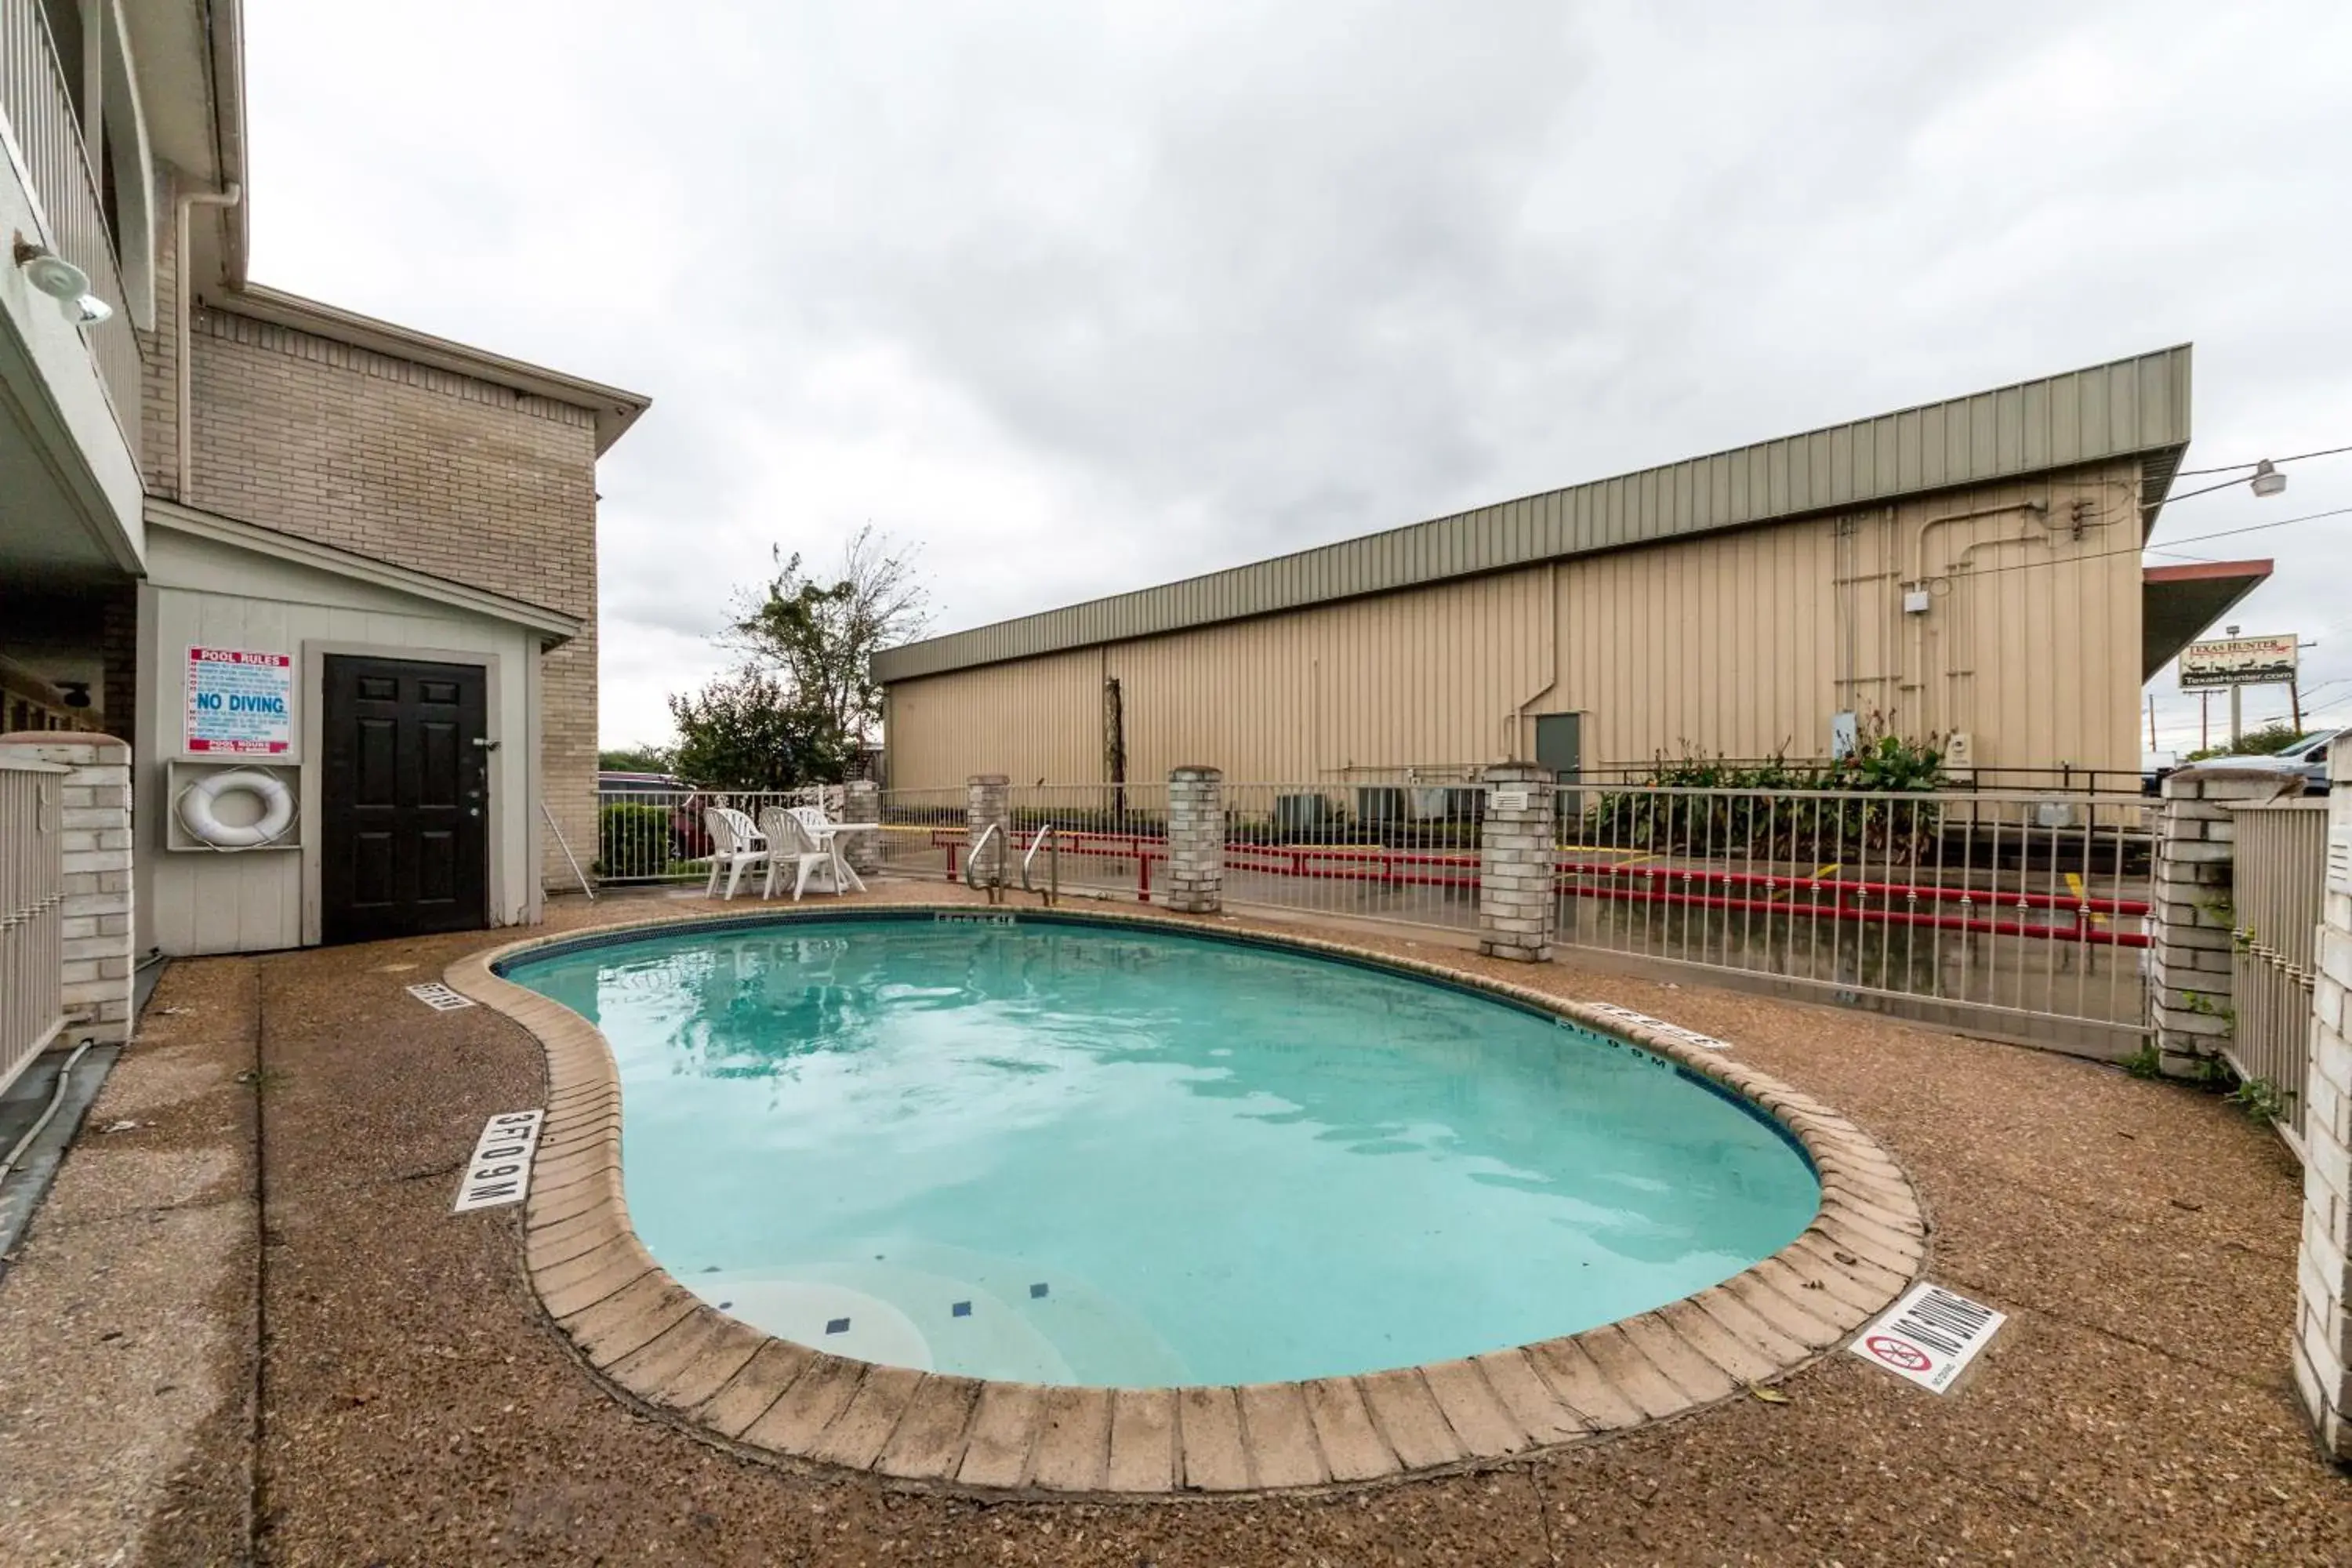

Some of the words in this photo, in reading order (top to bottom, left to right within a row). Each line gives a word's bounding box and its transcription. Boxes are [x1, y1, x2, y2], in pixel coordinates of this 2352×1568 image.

[201, 651, 236, 662] POOL
[2190, 645, 2224, 654] TEXAS
[2227, 640, 2277, 652] HUNTER
[198, 693, 222, 710] NO
[230, 695, 284, 713] DIVING
[1907, 1288, 1994, 1340] DIVING
[1890, 1319, 1963, 1357] NO
